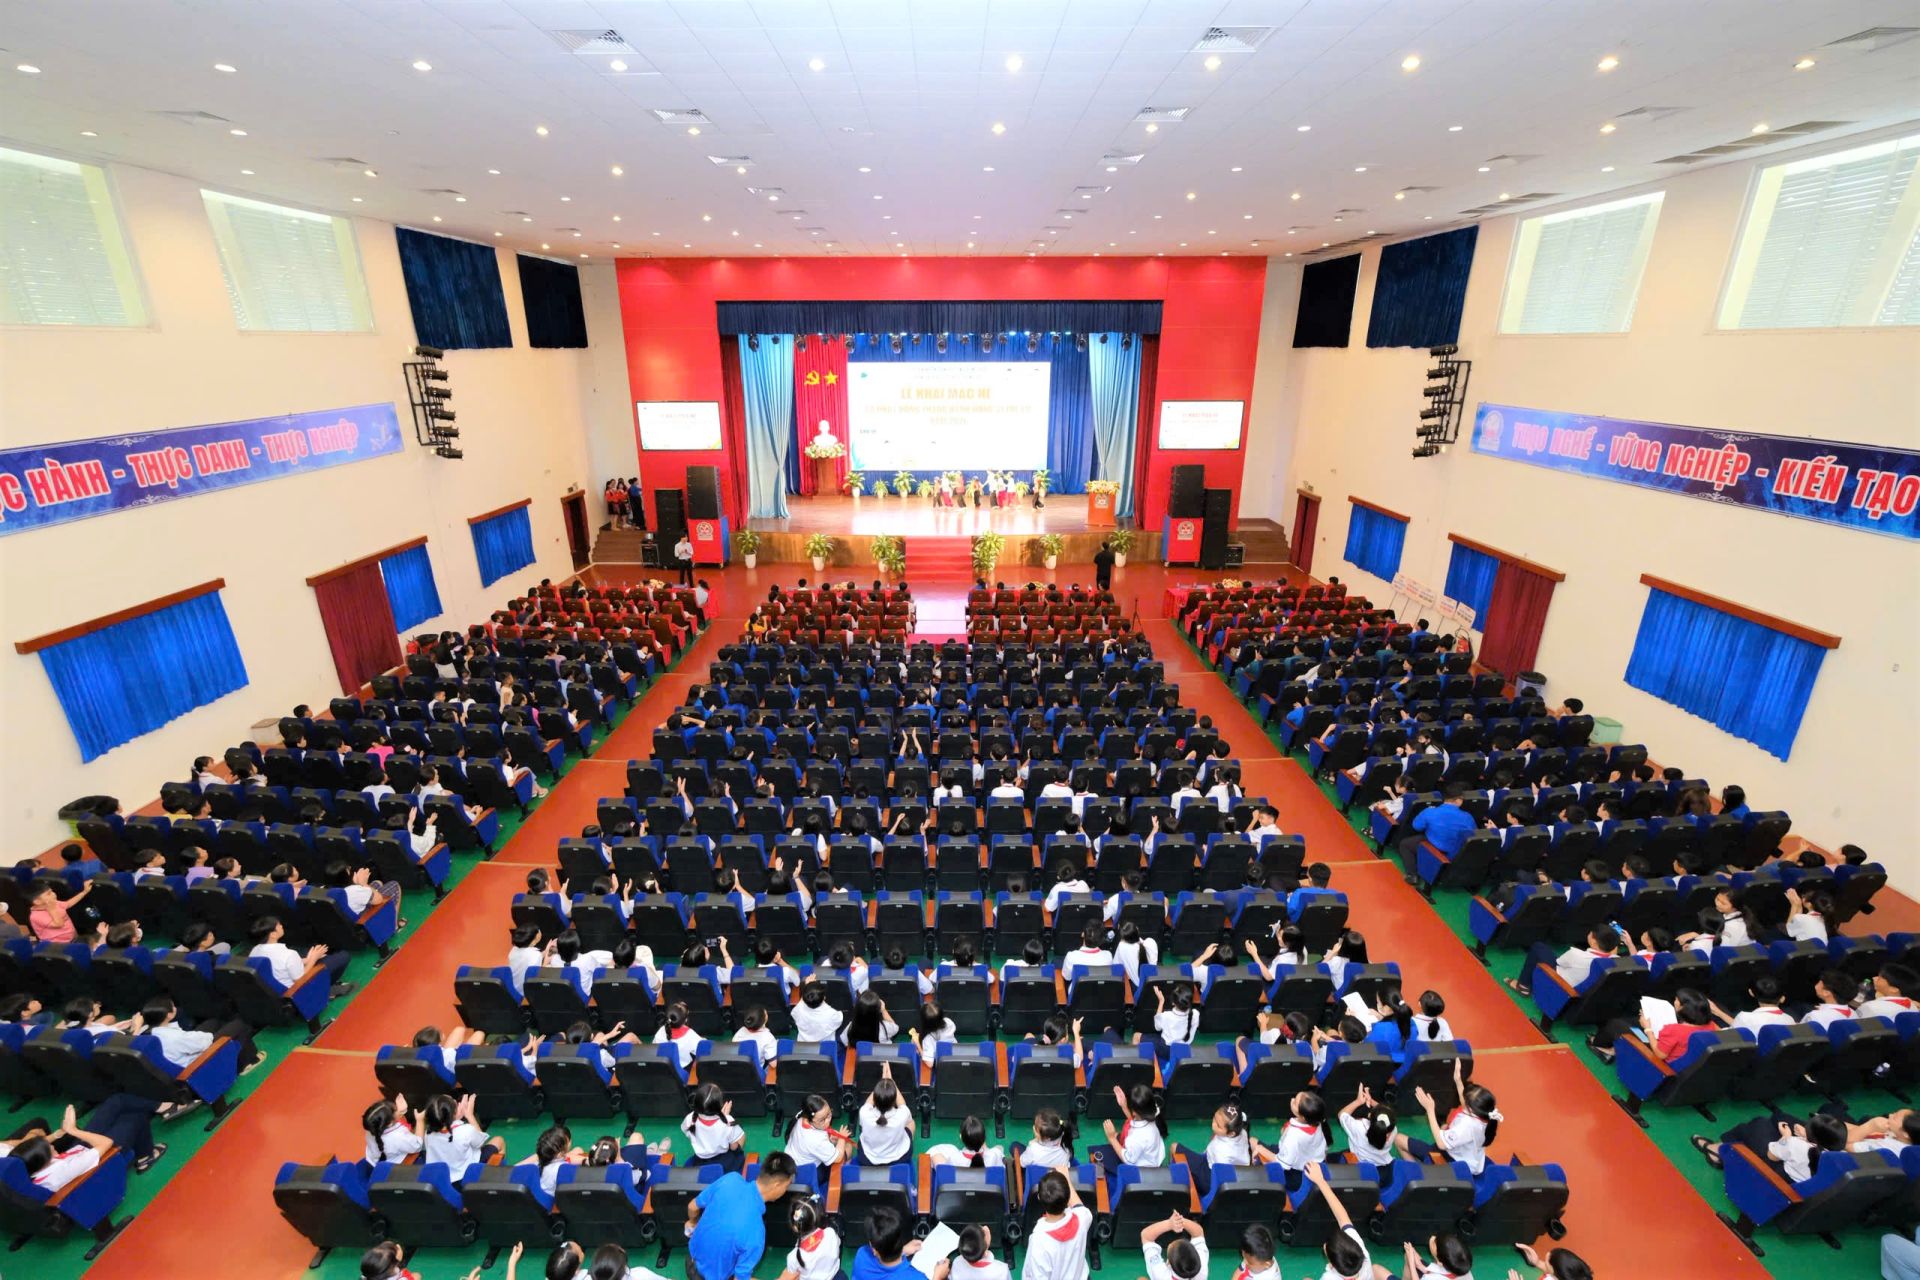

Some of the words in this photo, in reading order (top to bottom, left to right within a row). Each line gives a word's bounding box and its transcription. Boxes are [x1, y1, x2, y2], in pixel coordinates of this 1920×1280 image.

[0, 473, 27, 523] C
[24, 458, 112, 507] HÀNH
[112, 469, 126, 479] -
[126, 446, 193, 489] THỰC
[192, 438, 251, 476] DANH
[251, 447, 261, 455] -
[261, 429, 309, 465] THỰC
[307, 418, 360, 455] NGHIỆP
[1596, 444, 1606, 452] -
[1608, 432, 1662, 472] VỮNG
[1664, 443, 1751, 491] NGHIỆP
[1755, 467, 1770, 477] -
[1773, 455, 1849, 504] KIẾN
[1851, 468, 1920, 520] TẠO
